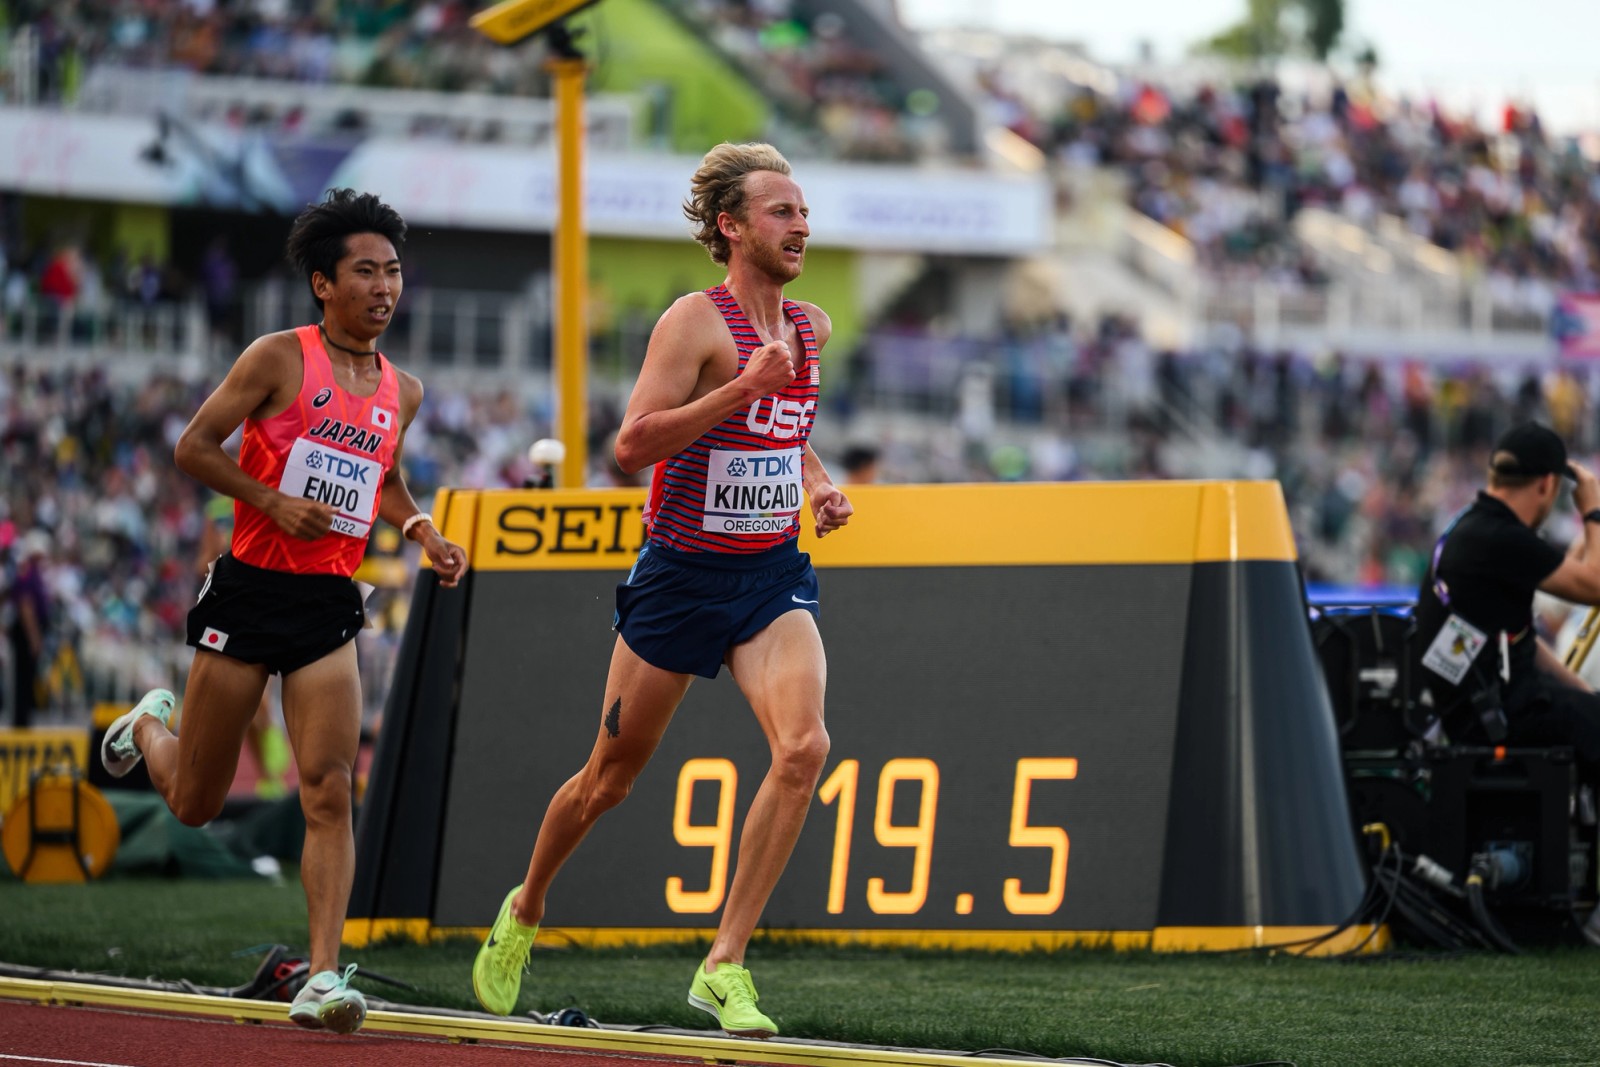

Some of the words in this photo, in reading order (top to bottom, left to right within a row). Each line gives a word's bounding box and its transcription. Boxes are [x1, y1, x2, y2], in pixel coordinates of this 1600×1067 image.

[310, 418, 383, 454] JAPAN
[324, 454, 370, 485] TDK
[747, 455, 793, 477] TDK
[303, 476, 359, 512] ENDO
[714, 483, 799, 510] KINCAID
[496, 505, 650, 555] SEI
[724, 519, 789, 532] OREGON2
